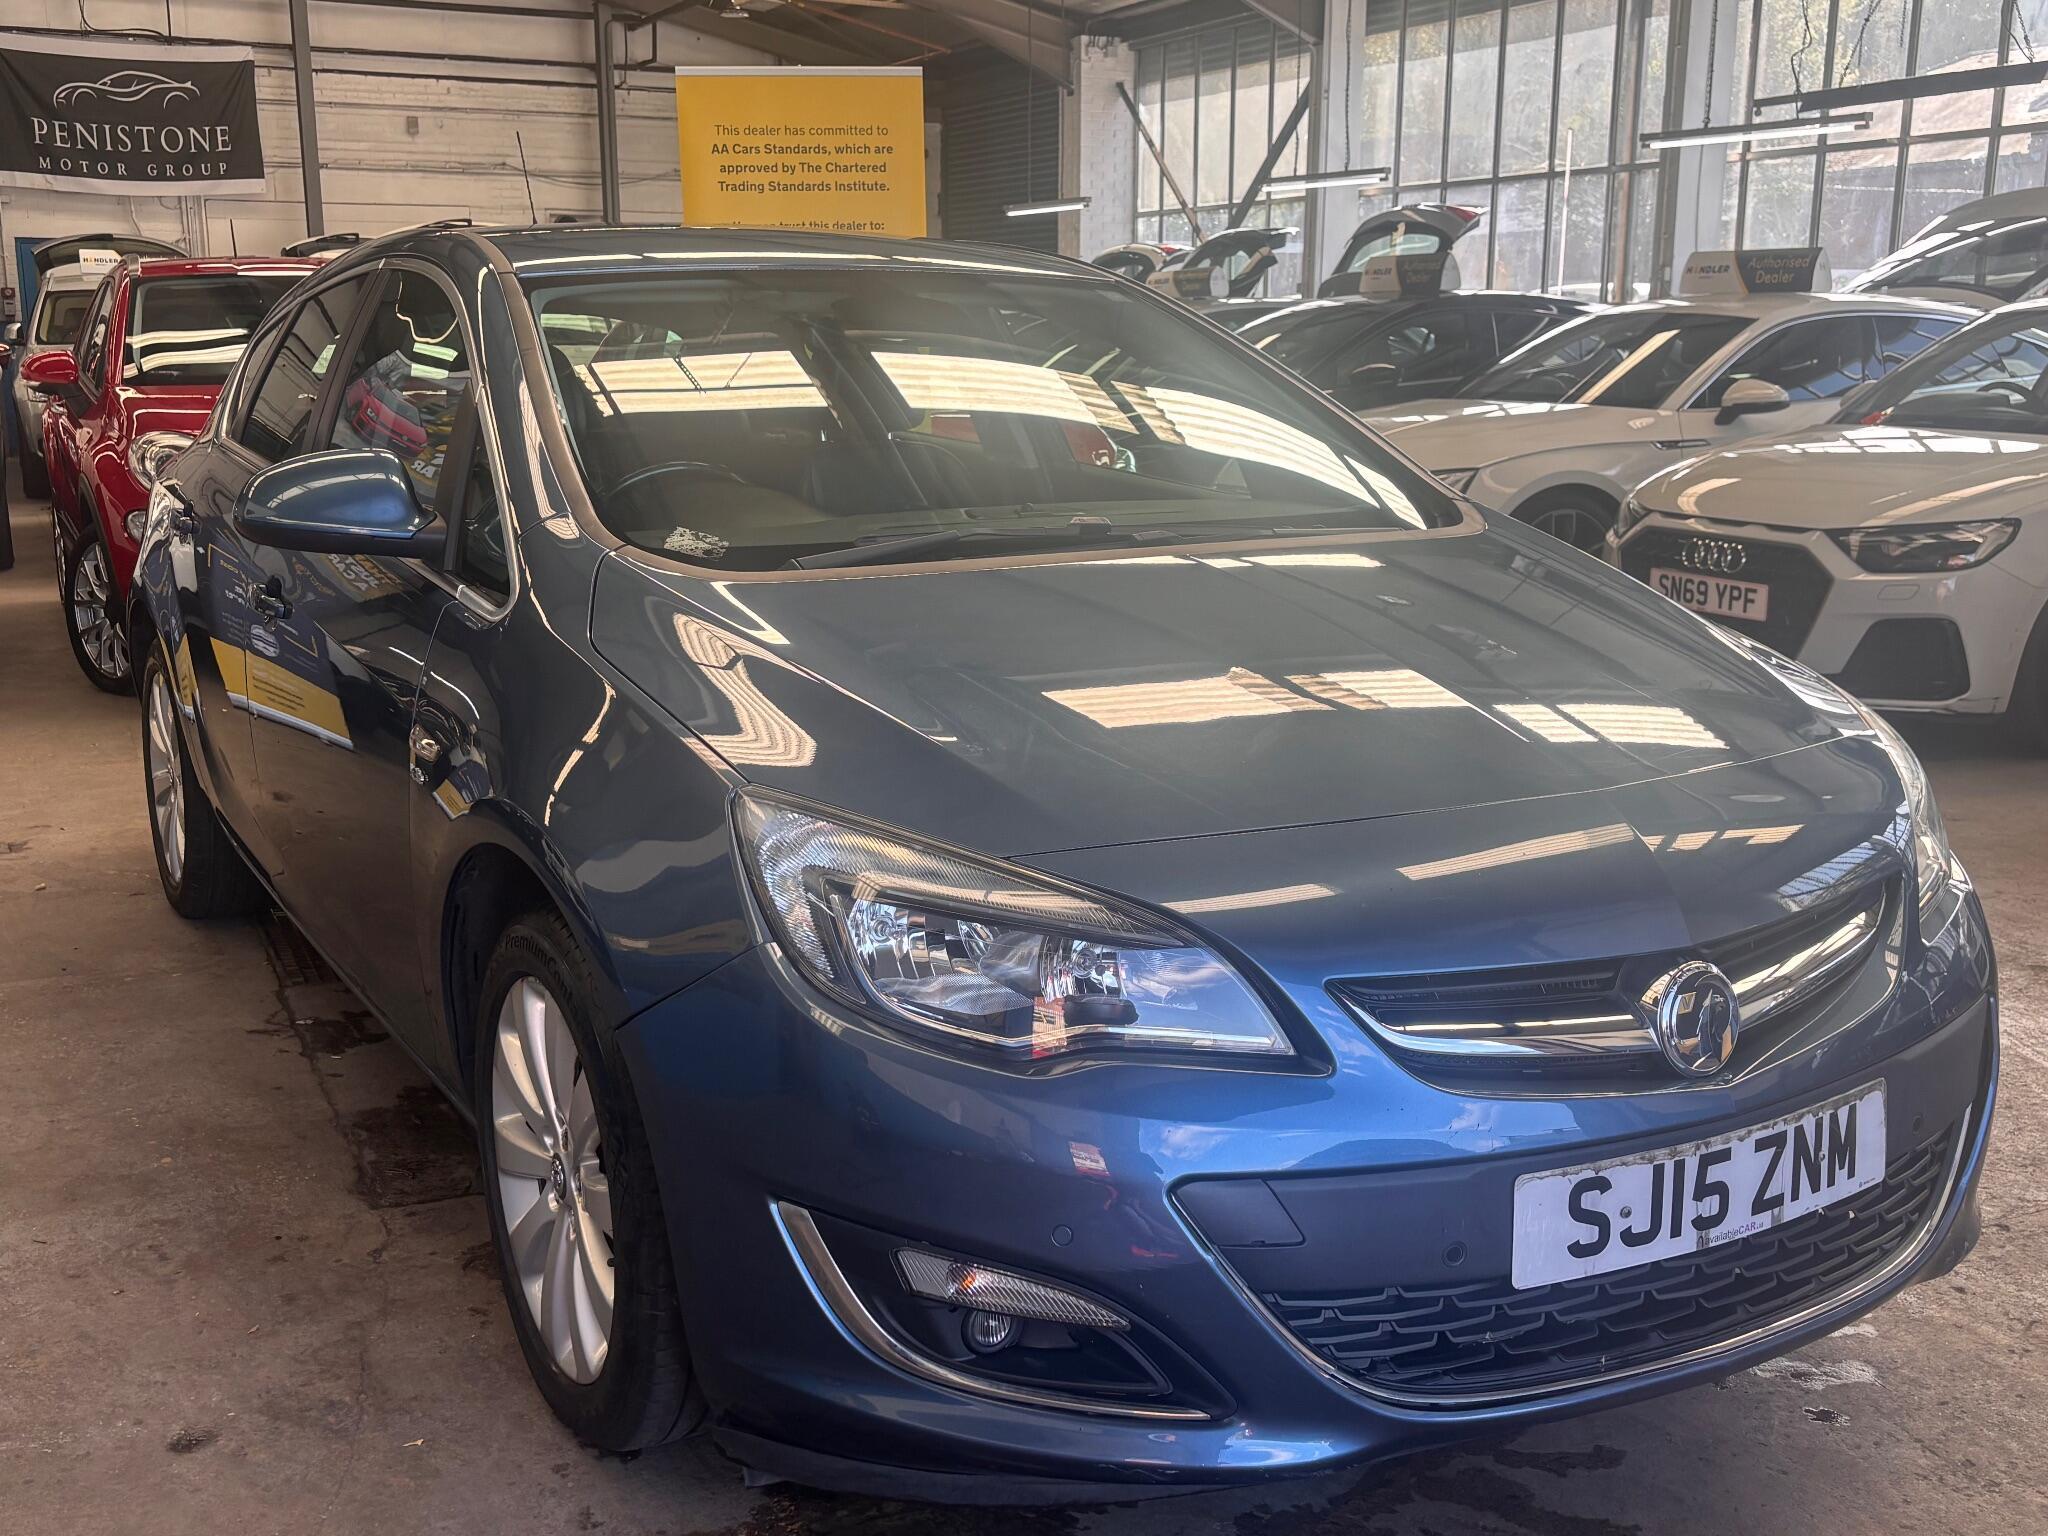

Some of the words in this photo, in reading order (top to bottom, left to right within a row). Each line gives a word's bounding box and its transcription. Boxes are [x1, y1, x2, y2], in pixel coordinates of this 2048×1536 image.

[31, 117, 232, 153] PENISTONE
[714, 125, 740, 136] This
[743, 125, 782, 136] dealer
[784, 125, 806, 136] has
[808, 125, 873, 136] committed
[876, 125, 889, 136] to
[711, 144, 729, 155] AA
[732, 144, 761, 155] Cars
[764, 144, 832, 156] Standards,
[834, 144, 871, 155] which
[874, 146, 894, 155] are
[39, 156, 128, 176] MOTOR
[147, 161, 228, 177] GROUP
[719, 162, 779, 174] approved
[782, 162, 796, 175] by
[799, 162, 822, 173] The
[825, 162, 887, 173] Chartered
[718, 181, 765, 193] Trading
[768, 180, 832, 192] Standards
[834, 181, 890, 192] Institute.
[832, 220, 867, 231] dealer
[870, 220, 885, 231] to:
[1755, 271, 1795, 283] Dealer
[1658, 573, 1709, 606] SN69
[1715, 582, 1758, 614] YPF
[1566, 1147, 1732, 1259] SJ15
[1751, 1102, 1857, 1217] ZNM
